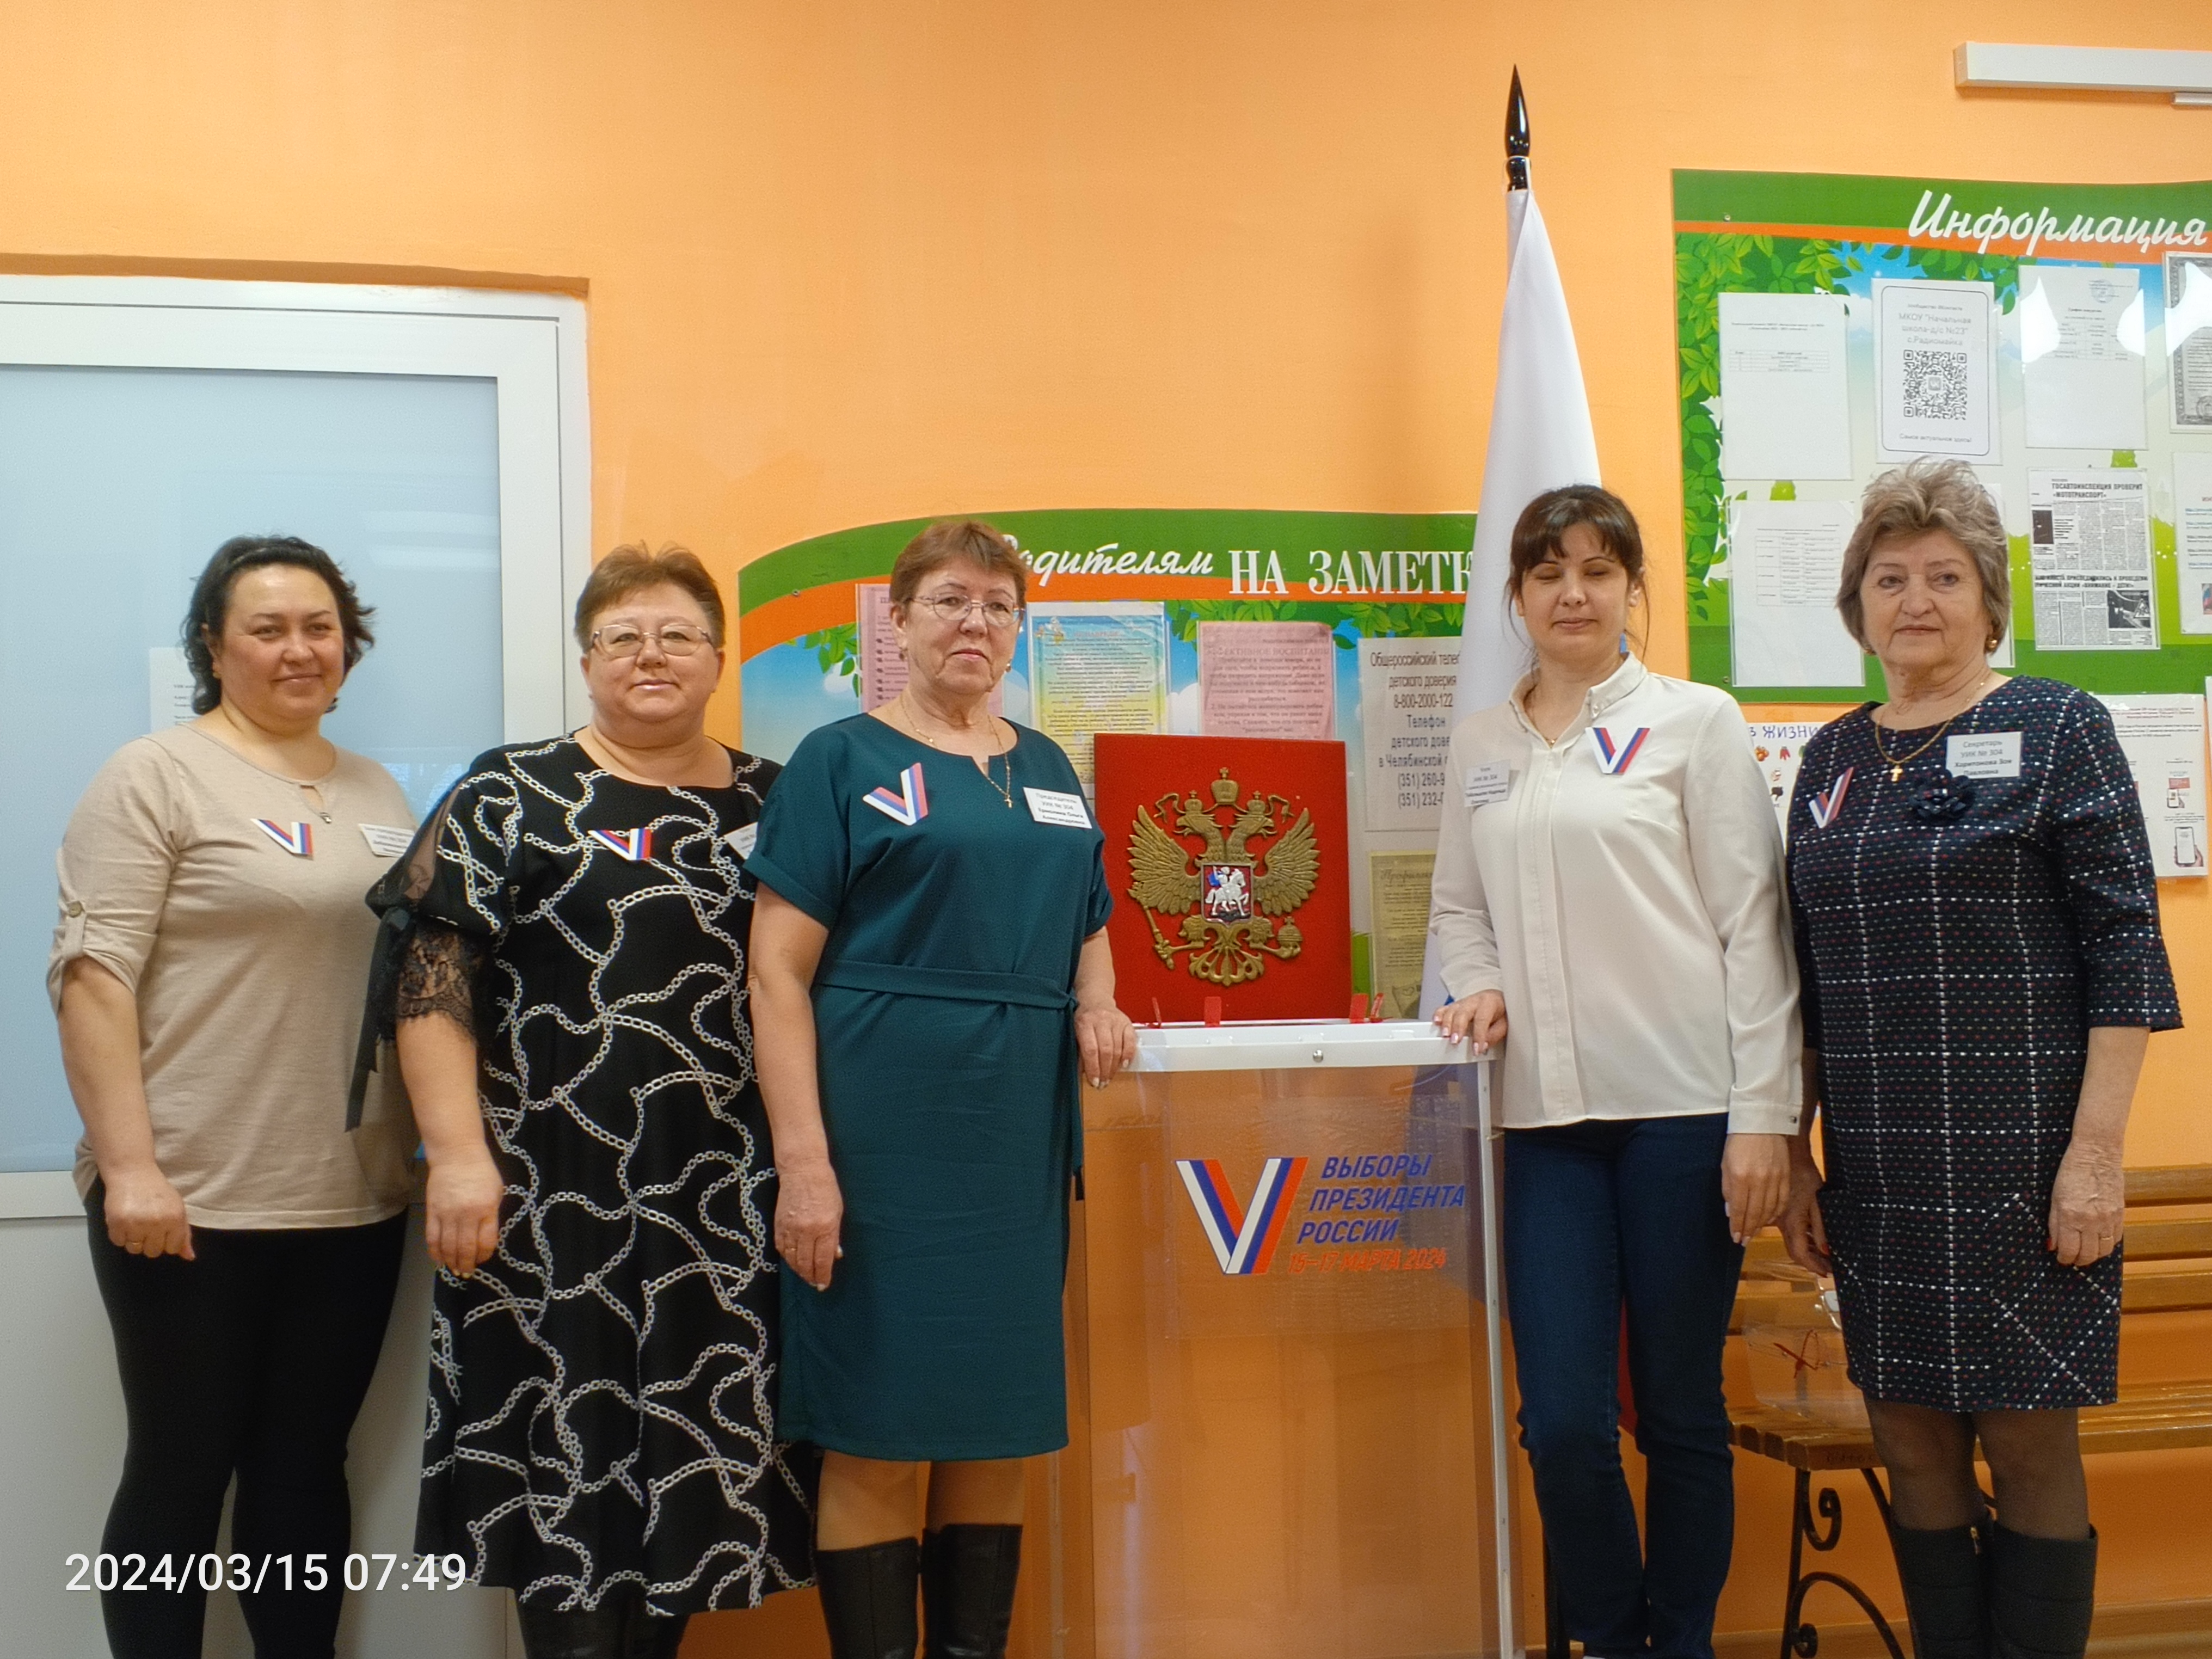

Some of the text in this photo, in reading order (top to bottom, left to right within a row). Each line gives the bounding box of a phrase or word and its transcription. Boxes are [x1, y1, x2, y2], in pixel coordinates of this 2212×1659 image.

[1908, 189, 2207, 256] Информация
[1899, 312, 1923, 321] МКОУ
[1228, 550, 1289, 594] НА
[1371, 652, 1437, 669] Общероссийский
[1388, 675, 1457, 690] детского доверия
[1393, 693, 1453, 708] 8-800-2000-122
[1406, 714, 1446, 730] Телефон
[1391, 736, 1428, 750] детского
[1386, 753, 1442, 767] Челябинской
[1398, 772, 1420, 789] (351)
[1398, 792, 1420, 809] (351)
[1320, 1153, 1433, 1179] ВЫБОРЫ
[1308, 1184, 1466, 1213] ПРЕЗИДЕНТА
[1297, 1218, 1400, 1245] РОССИИ
[1340, 1249, 1401, 1273] МАРТА
[1403, 1248, 1447, 1270] 2024
